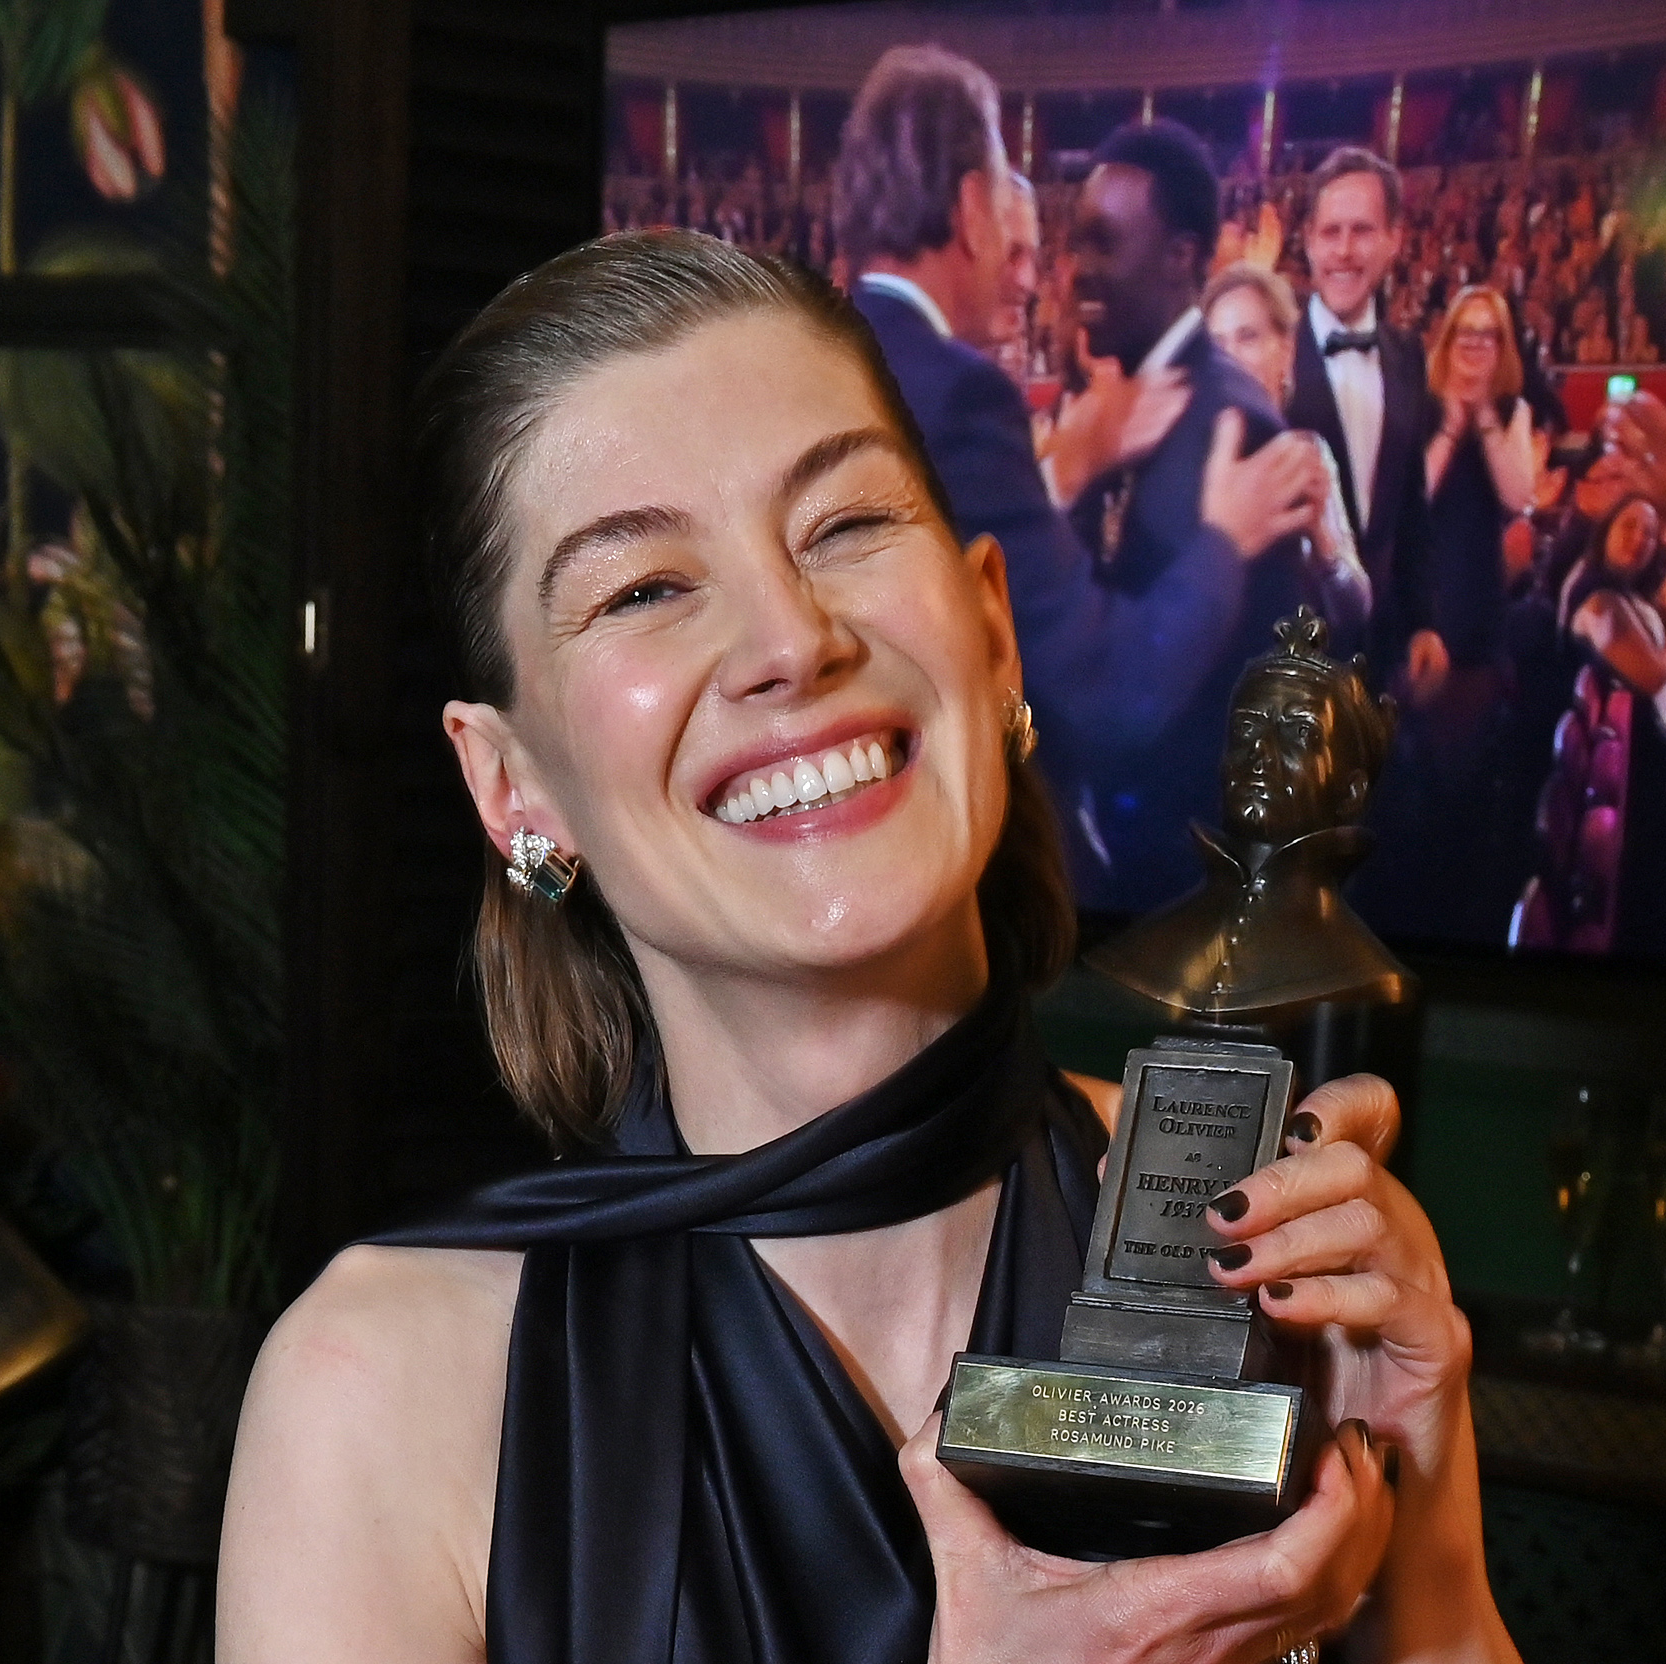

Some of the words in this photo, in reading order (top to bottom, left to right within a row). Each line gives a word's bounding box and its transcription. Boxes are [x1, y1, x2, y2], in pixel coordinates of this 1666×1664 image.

[1152, 1096, 1252, 1119] LAURENCE
[1159, 1117, 1236, 1138] OLIVIER
[1137, 1173, 1217, 1196] HENRY
[1160, 1200, 1208, 1218] 1937
[1124, 1241, 1157, 1255] THE
[1161, 1244, 1195, 1258] OLD
[1032, 1385, 1091, 1403] OLIVIER
[1099, 1392, 1161, 1410] AWARDS
[1168, 1400, 1205, 1415] 2026
[1058, 1409, 1096, 1424] BEST
[1102, 1414, 1170, 1433] ACTRESS
[1051, 1429, 1133, 1449] ROSAMUND
[1140, 1438, 1176, 1454] PIKE
